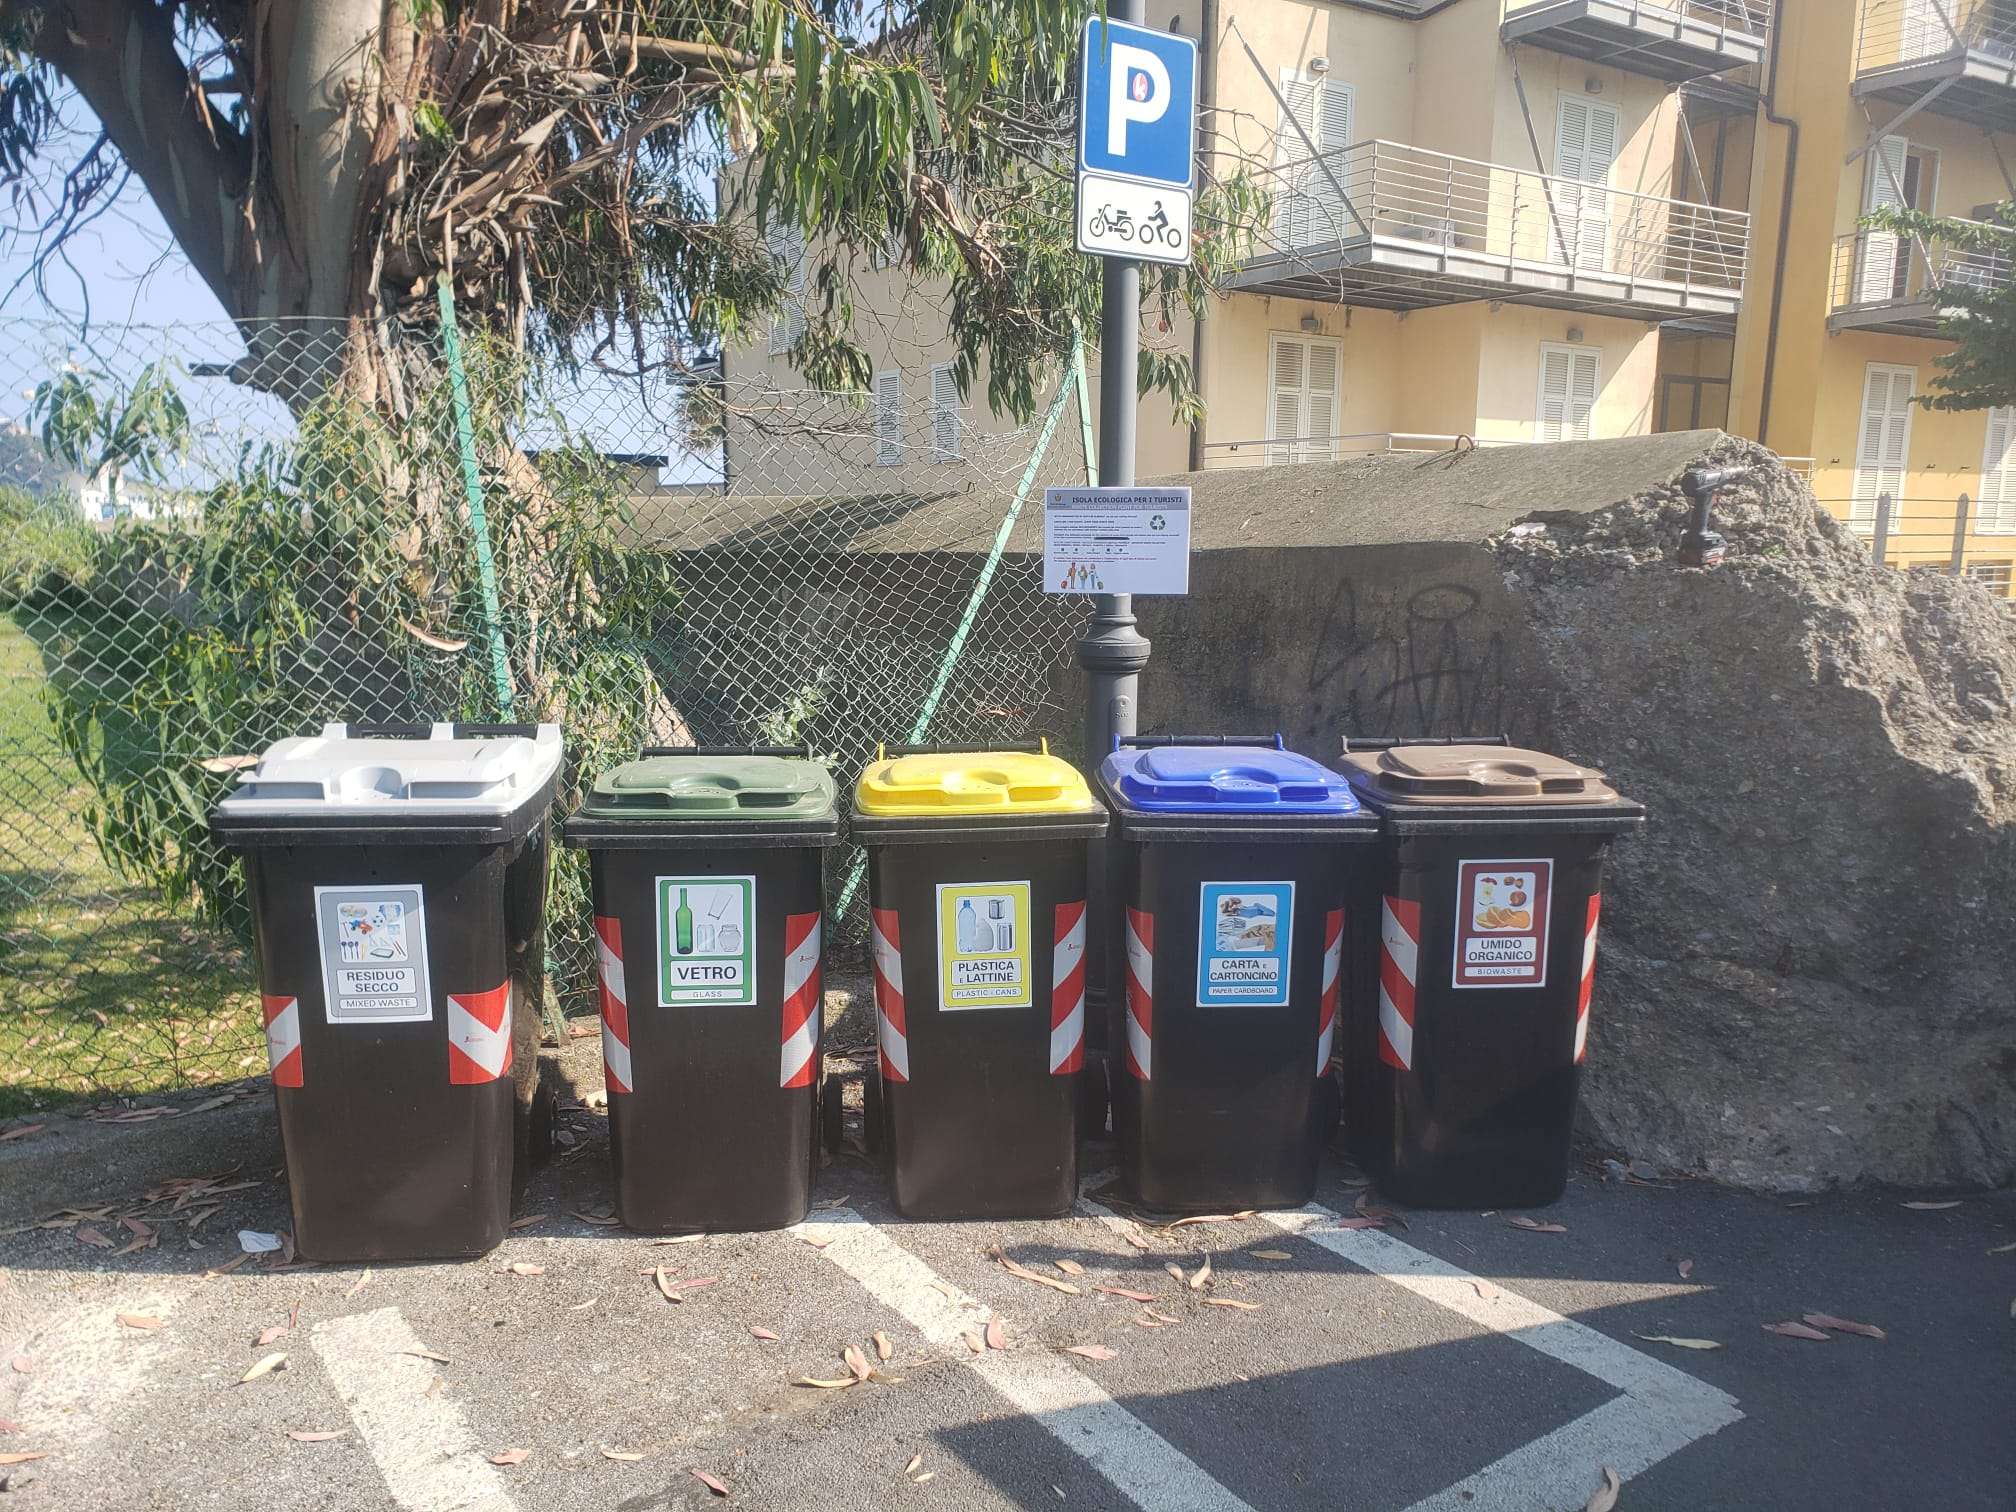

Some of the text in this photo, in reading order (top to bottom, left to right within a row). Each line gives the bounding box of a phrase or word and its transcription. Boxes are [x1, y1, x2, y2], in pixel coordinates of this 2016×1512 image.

[1108, 42, 1170, 157] P
[1072, 496, 1093, 504] ISOLA
[1093, 496, 1132, 504] ECOLOGICA
[1133, 496, 1147, 504] PER
[1154, 496, 1182, 504] TURISTI
[1481, 939, 1522, 949] UMIDO
[1468, 950, 1533, 961] ORGANICO
[958, 961, 1014, 972] PLASTICA
[1221, 959, 1260, 970] CARTA
[346, 970, 405, 981] RESIDUO
[677, 966, 737, 980] VETRO
[1209, 971, 1278, 981] CARTONCINO
[1477, 967, 1522, 976] BIOWASTE
[966, 972, 1014, 983] LATTINE
[355, 982, 399, 993] SECCO
[1234, 986, 1274, 995] CARDBOARD
[692, 990, 723, 998] GLASS
[956, 988, 989, 998] PLASTIC
[346, 998, 411, 1008] MIXED WASTE
